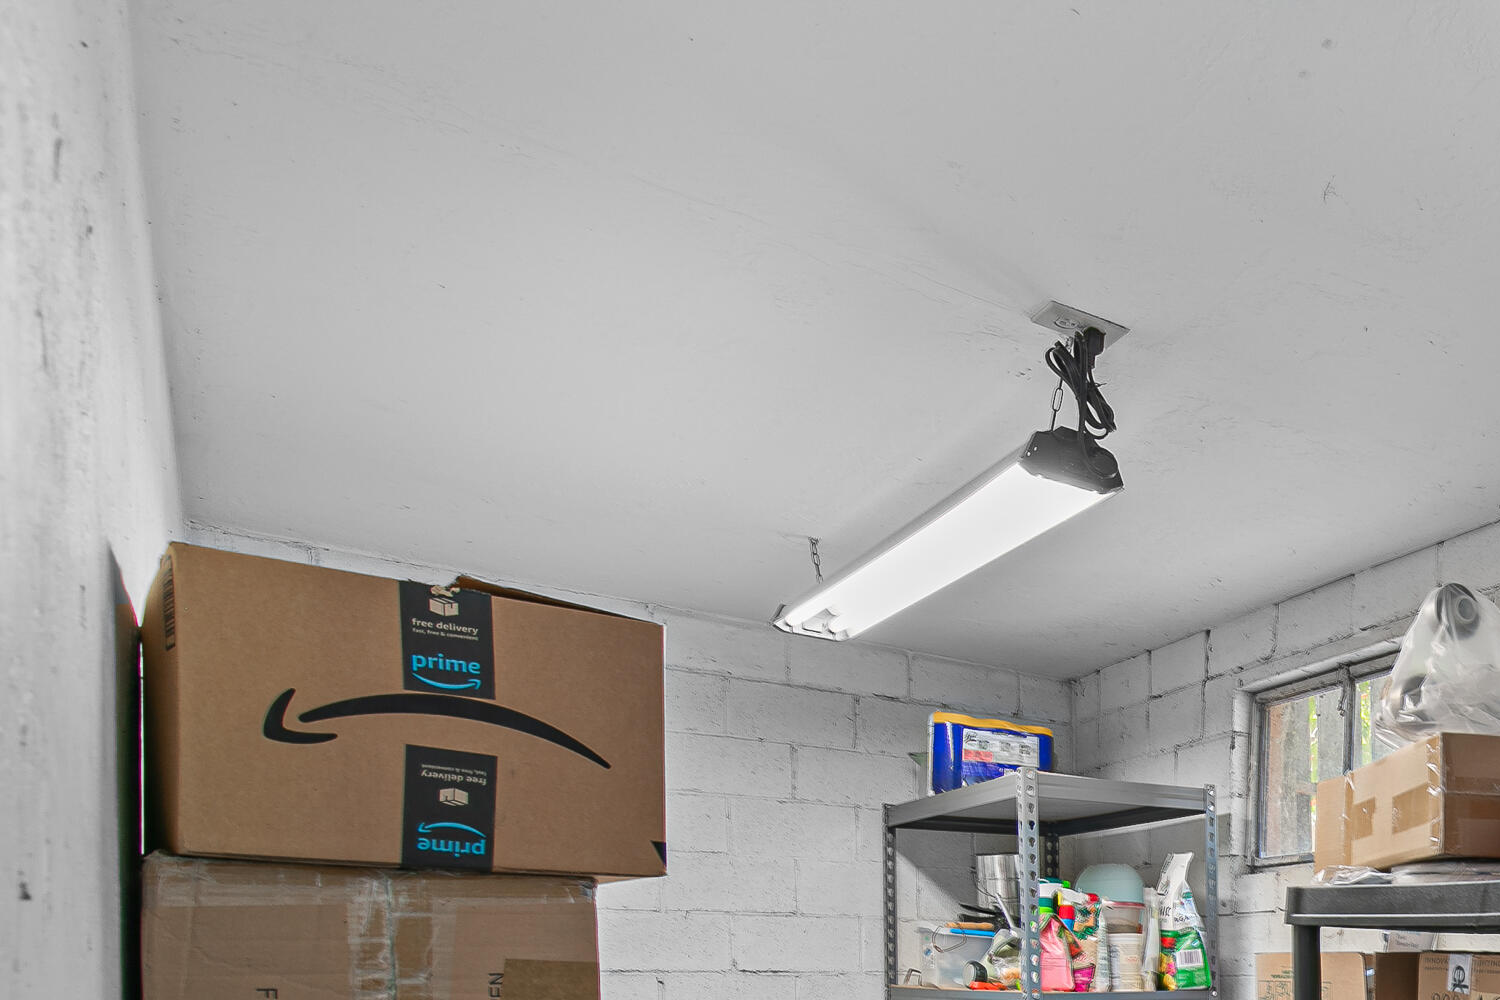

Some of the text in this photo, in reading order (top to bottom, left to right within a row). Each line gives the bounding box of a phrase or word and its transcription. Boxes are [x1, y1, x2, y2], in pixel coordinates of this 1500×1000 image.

[412, 618, 478, 635] free delivery
[412, 653, 480, 674] prime
[420, 769, 487, 786] free delivery
[416, 837, 486, 857] prime
